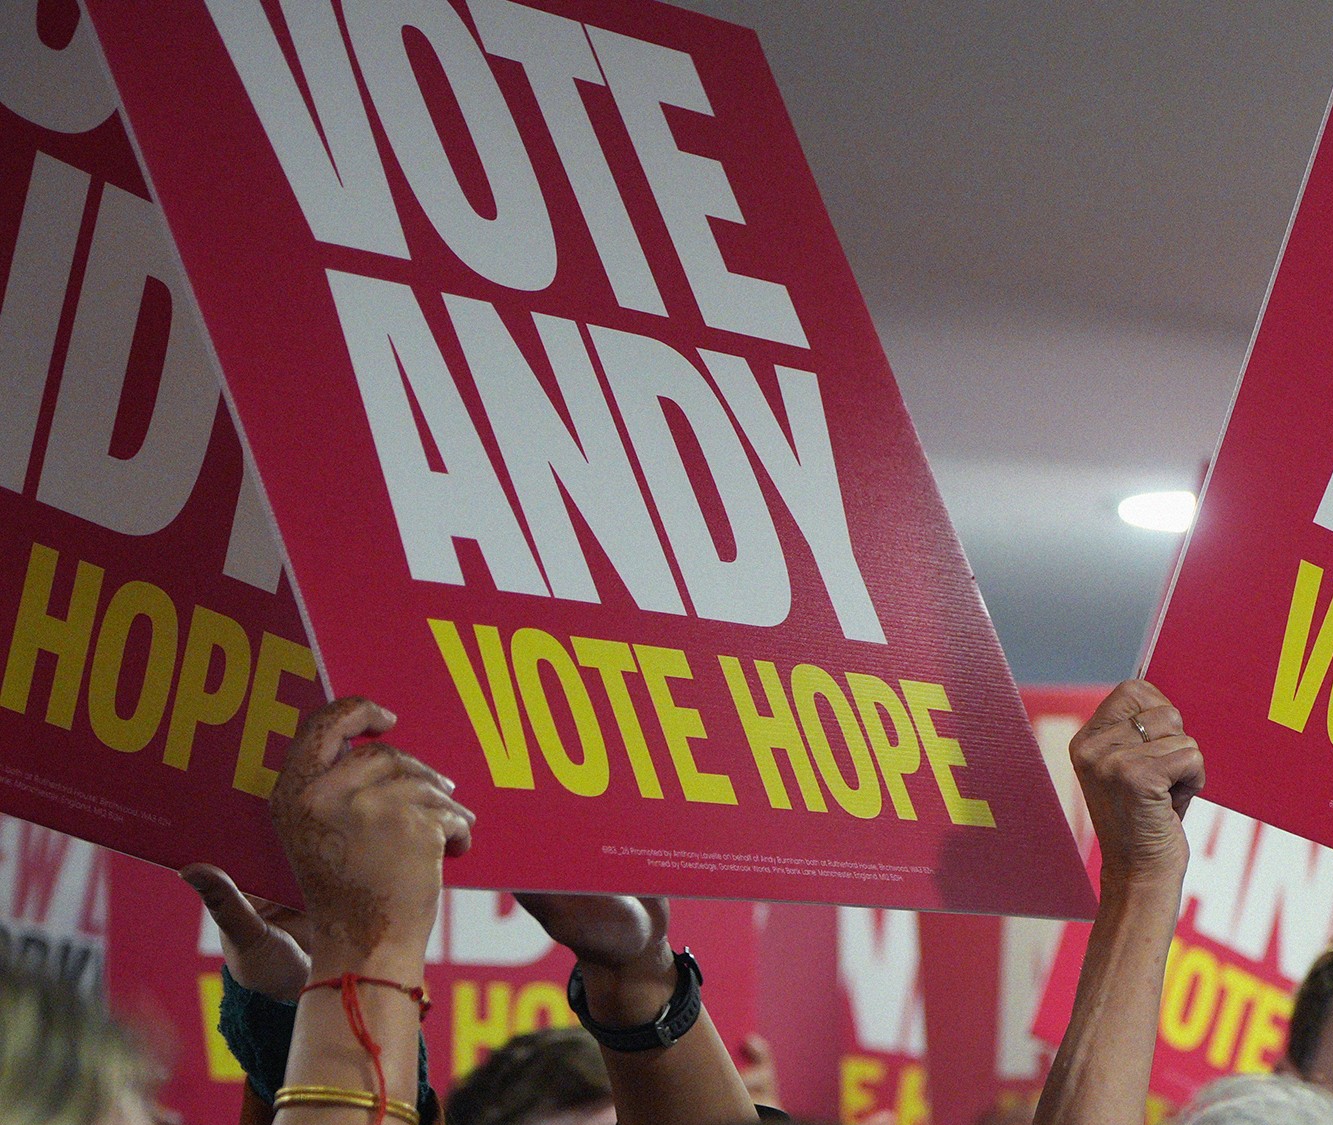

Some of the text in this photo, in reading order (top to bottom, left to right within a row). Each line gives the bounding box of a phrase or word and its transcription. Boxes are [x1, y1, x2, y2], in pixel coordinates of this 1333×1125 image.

[203, 0, 811, 349] VOTE
[325, 267, 889, 645] ANDY
[0, 543, 318, 799] HOPE
[427, 617, 738, 806] VOTE
[716, 654, 996, 828] HOPE
[663, 850, 672, 858] by
[671, 861, 679, 869] by
[1162, 935, 1298, 1078] OTE
